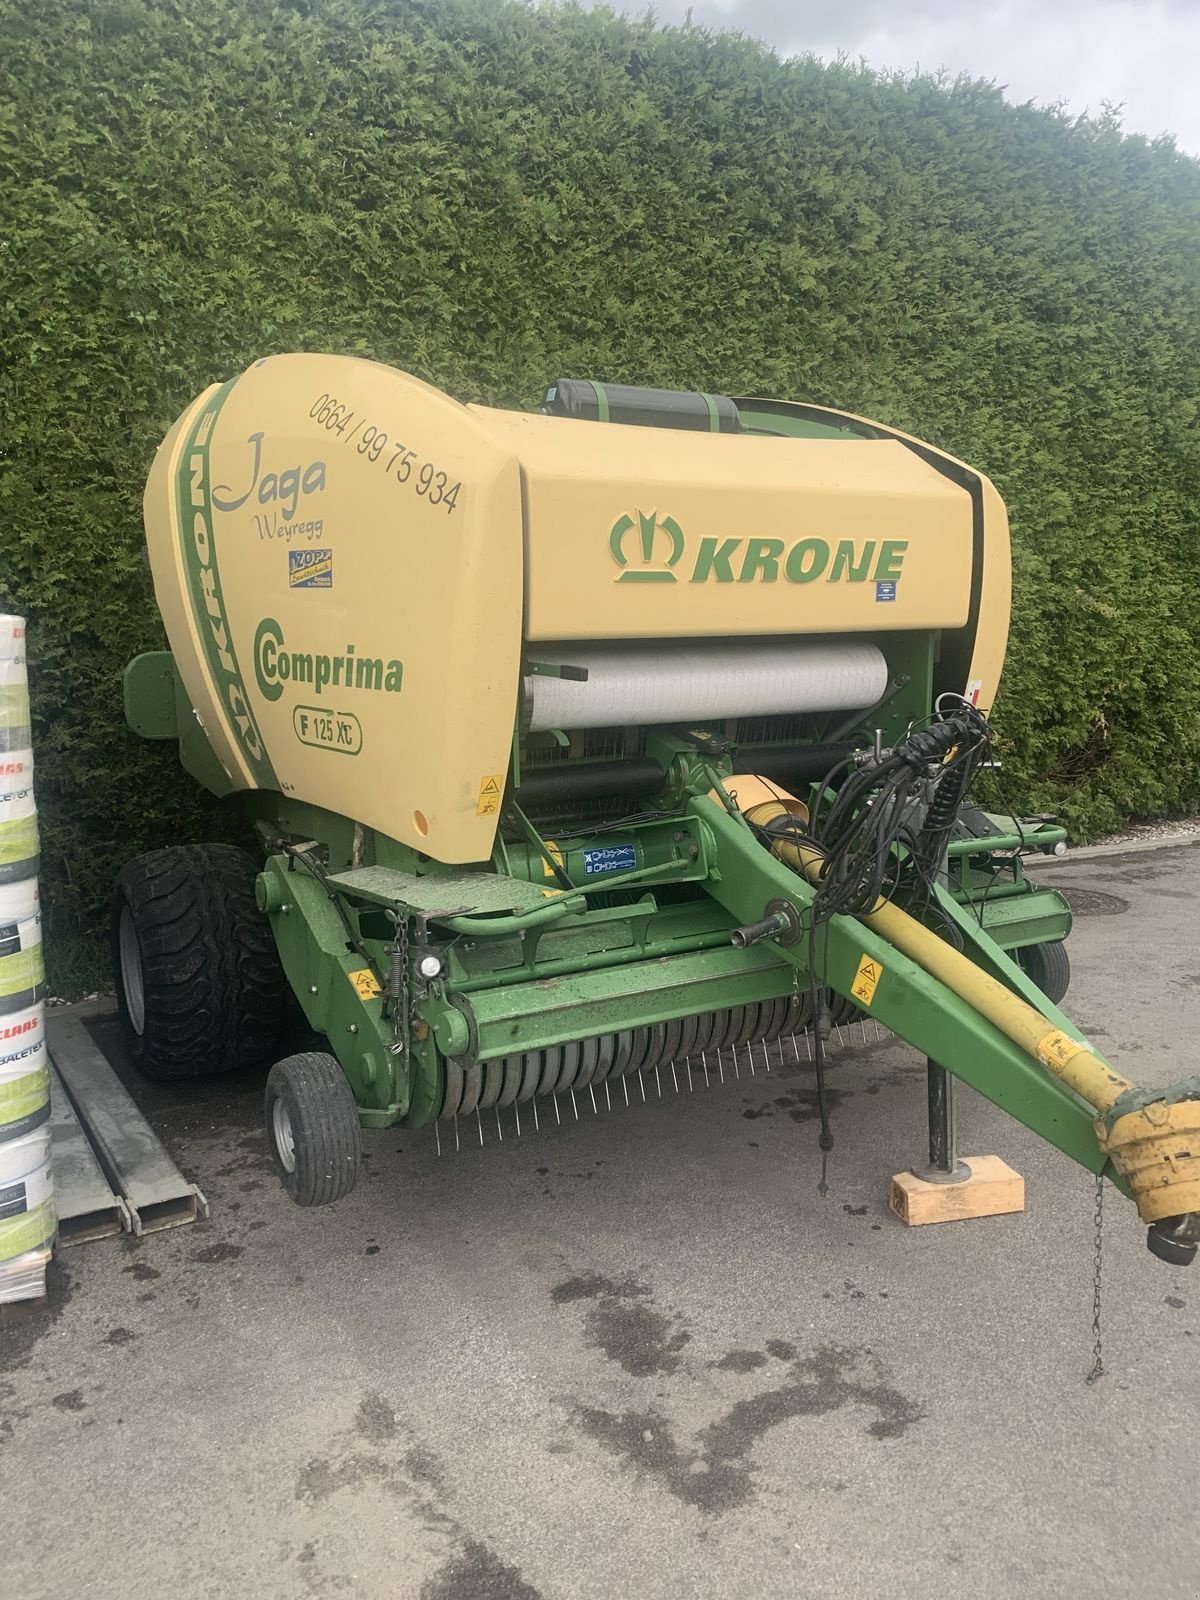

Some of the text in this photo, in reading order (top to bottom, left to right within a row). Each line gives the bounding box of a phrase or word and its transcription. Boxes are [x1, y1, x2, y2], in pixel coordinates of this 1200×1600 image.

[212, 432, 326, 521] Jaga
[309, 393, 355, 437] 0664
[357, 426, 388, 462] 99
[386, 442, 418, 483] 75
[416, 463, 462, 514] 934
[190, 410, 236, 675] KRONE
[251, 512, 323, 542] Weyregg
[688, 535, 909, 584] KRONE
[254, 618, 403, 701] Comprima
[300, 714, 353, 746] F 125 XC
